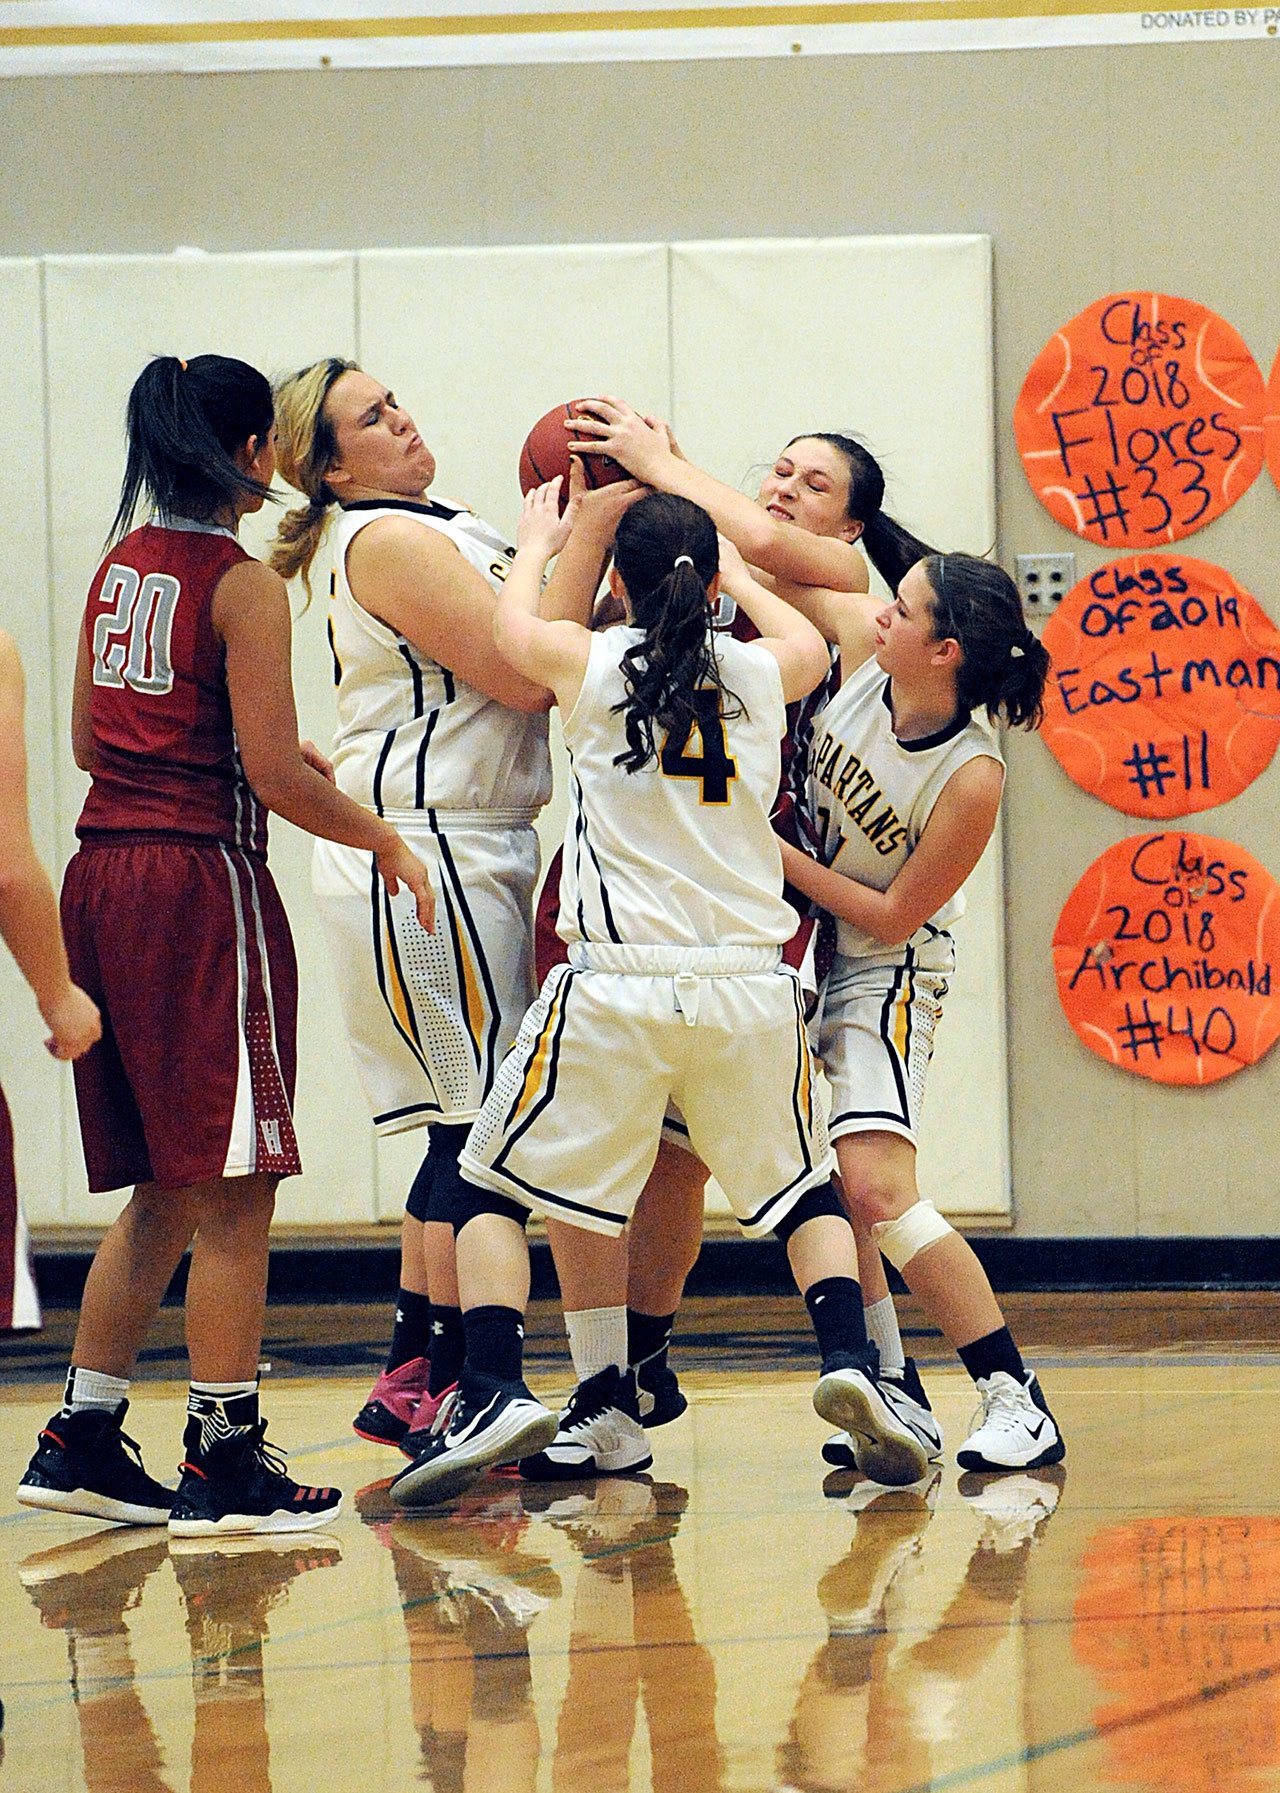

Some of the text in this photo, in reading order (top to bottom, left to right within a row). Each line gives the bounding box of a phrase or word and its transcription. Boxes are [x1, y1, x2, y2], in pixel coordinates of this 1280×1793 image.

[1141, 10, 1229, 29] DONATED
[1234, 9, 1258, 26] BY
[1089, 360, 1190, 409] 2018
[1052, 408, 1242, 478] Flores
[1077, 458, 1212, 540] #33
[92, 563, 182, 696] 20
[1056, 651, 1280, 716] Eastman
[660, 684, 739, 806] 4
[1123, 729, 1210, 799] #11
[1105, 905, 1215, 952] 2018
[1068, 947, 1272, 997] Archibald
[1117, 998, 1238, 1062] #40
